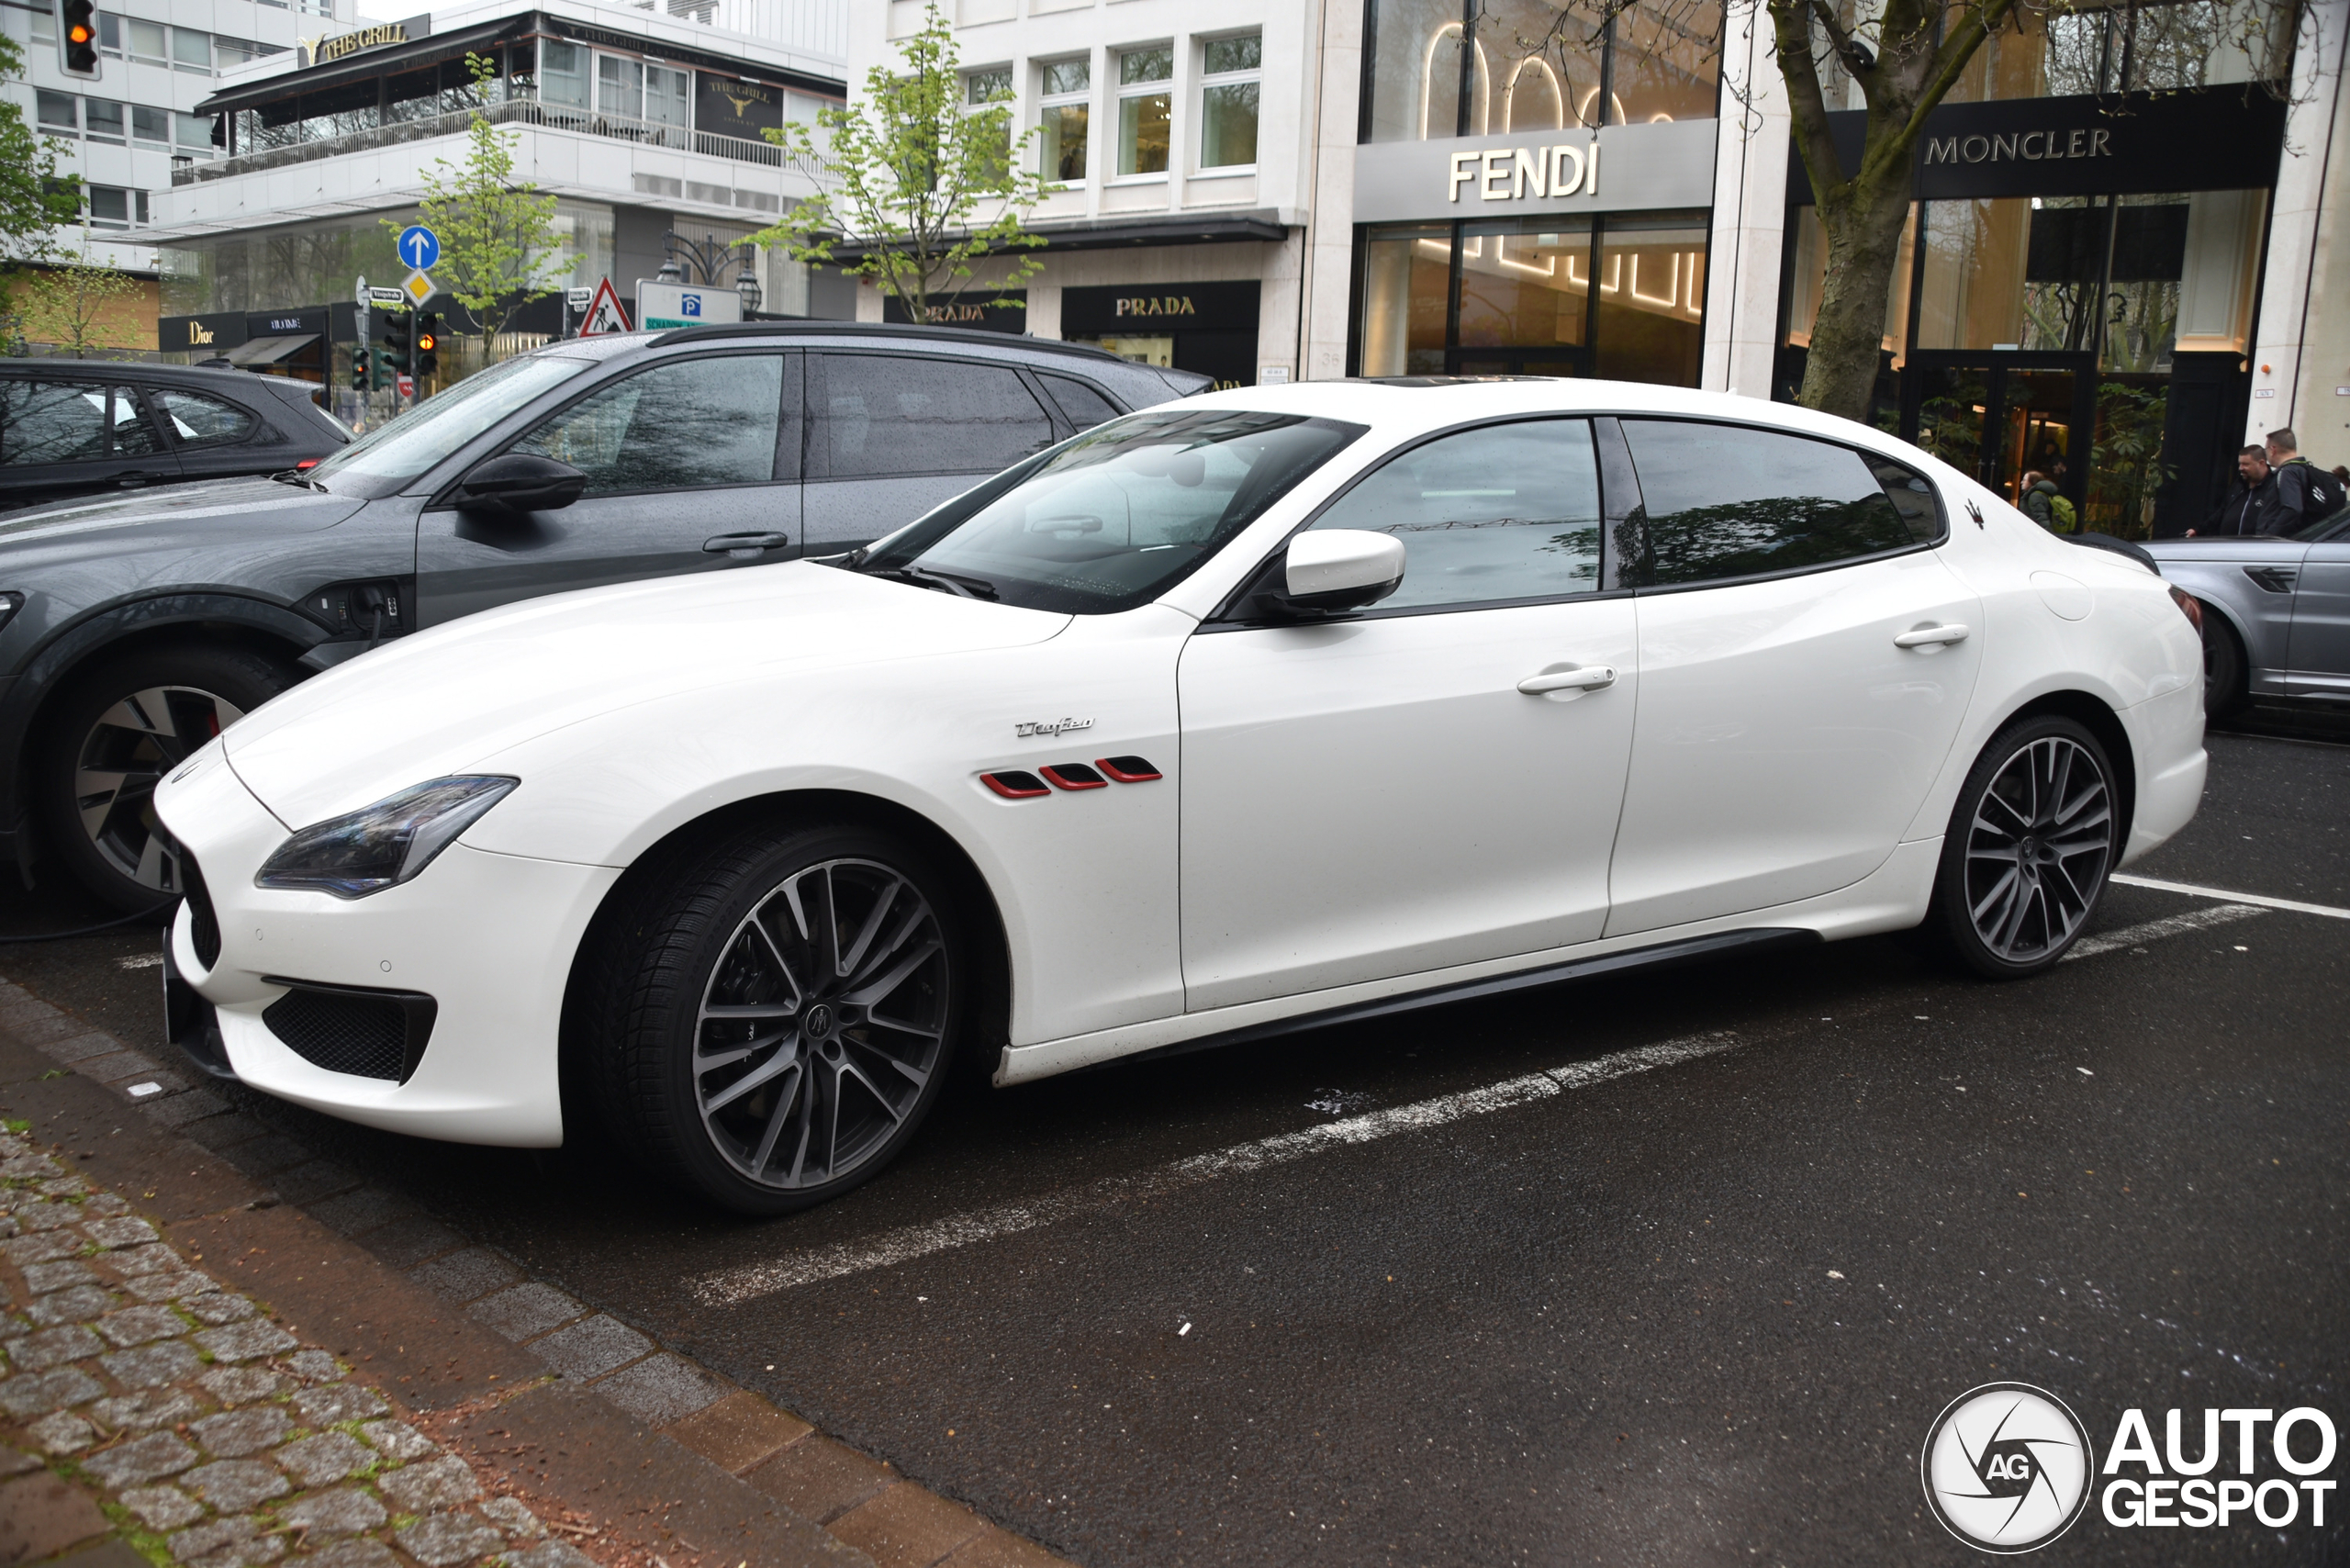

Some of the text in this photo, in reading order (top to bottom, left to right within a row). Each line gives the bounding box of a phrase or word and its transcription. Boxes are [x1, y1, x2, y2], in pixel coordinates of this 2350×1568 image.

[324, 24, 406, 61] THE GRILL
[710, 81, 770, 105] THE GRILL
[1924, 128, 2112, 165] MONCLER
[1449, 142, 1601, 203] FENDI
[1116, 296, 1196, 317] PRADA
[189, 321, 214, 345] Dior
[1321, 353, 1340, 366] 36
[1015, 717, 1096, 737] Trofeo
